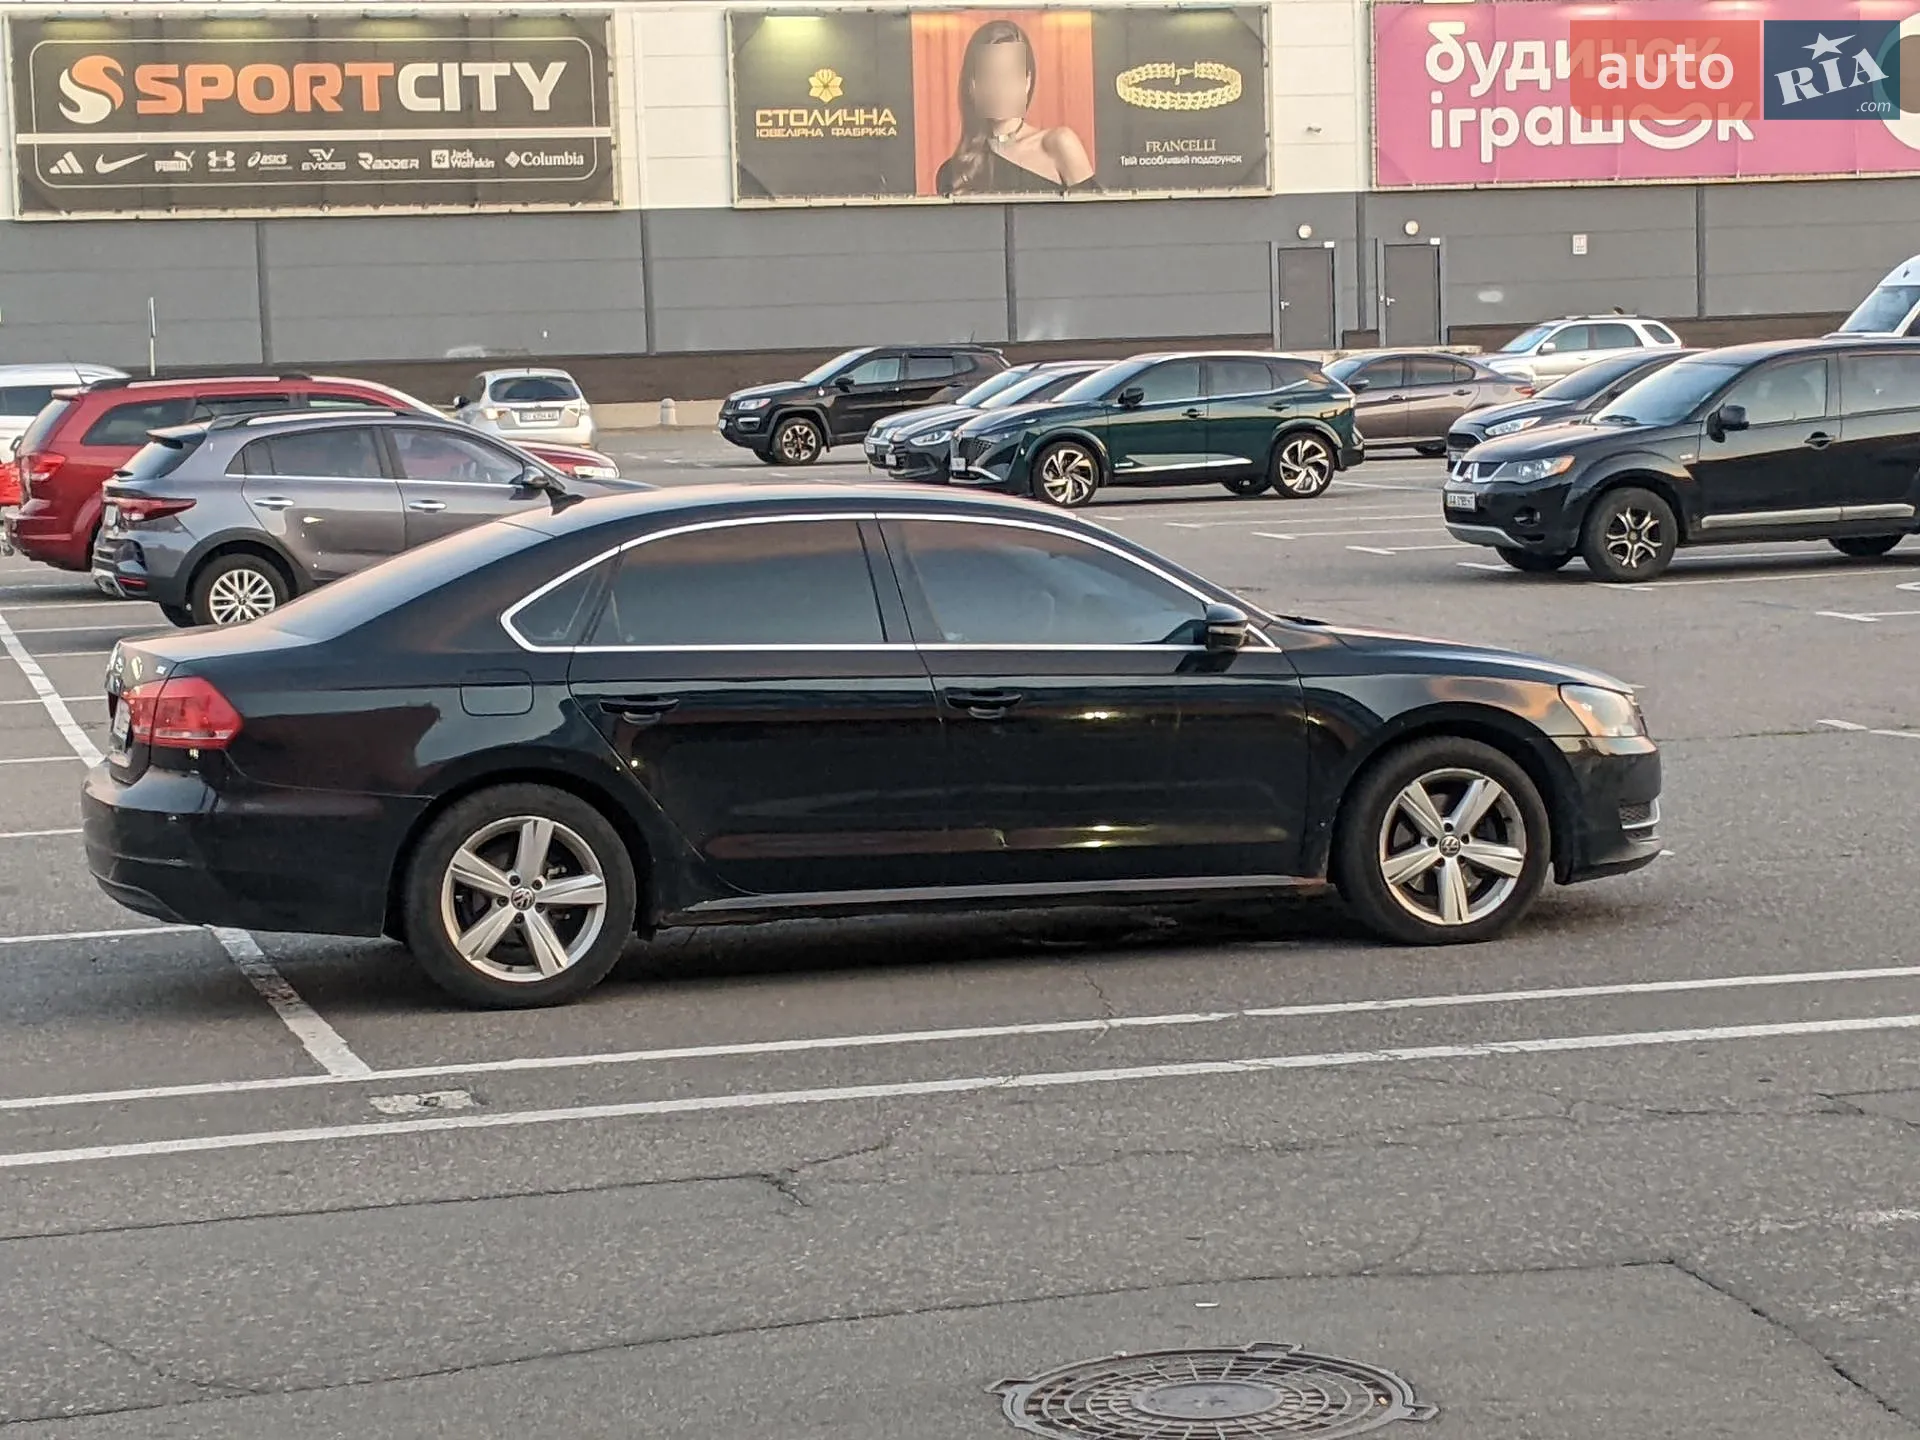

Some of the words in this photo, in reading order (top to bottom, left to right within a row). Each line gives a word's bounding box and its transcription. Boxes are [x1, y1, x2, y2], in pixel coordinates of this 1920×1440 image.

[135, 62, 567, 114] SPORTCITY
[755, 107, 897, 127] СТОЛИЧНА
[831, 127, 897, 138] ФАБРИКА
[1145, 138, 1217, 152] FRANCELLI
[451, 149, 473, 158] Jack
[520, 151, 584, 167] Columbia
